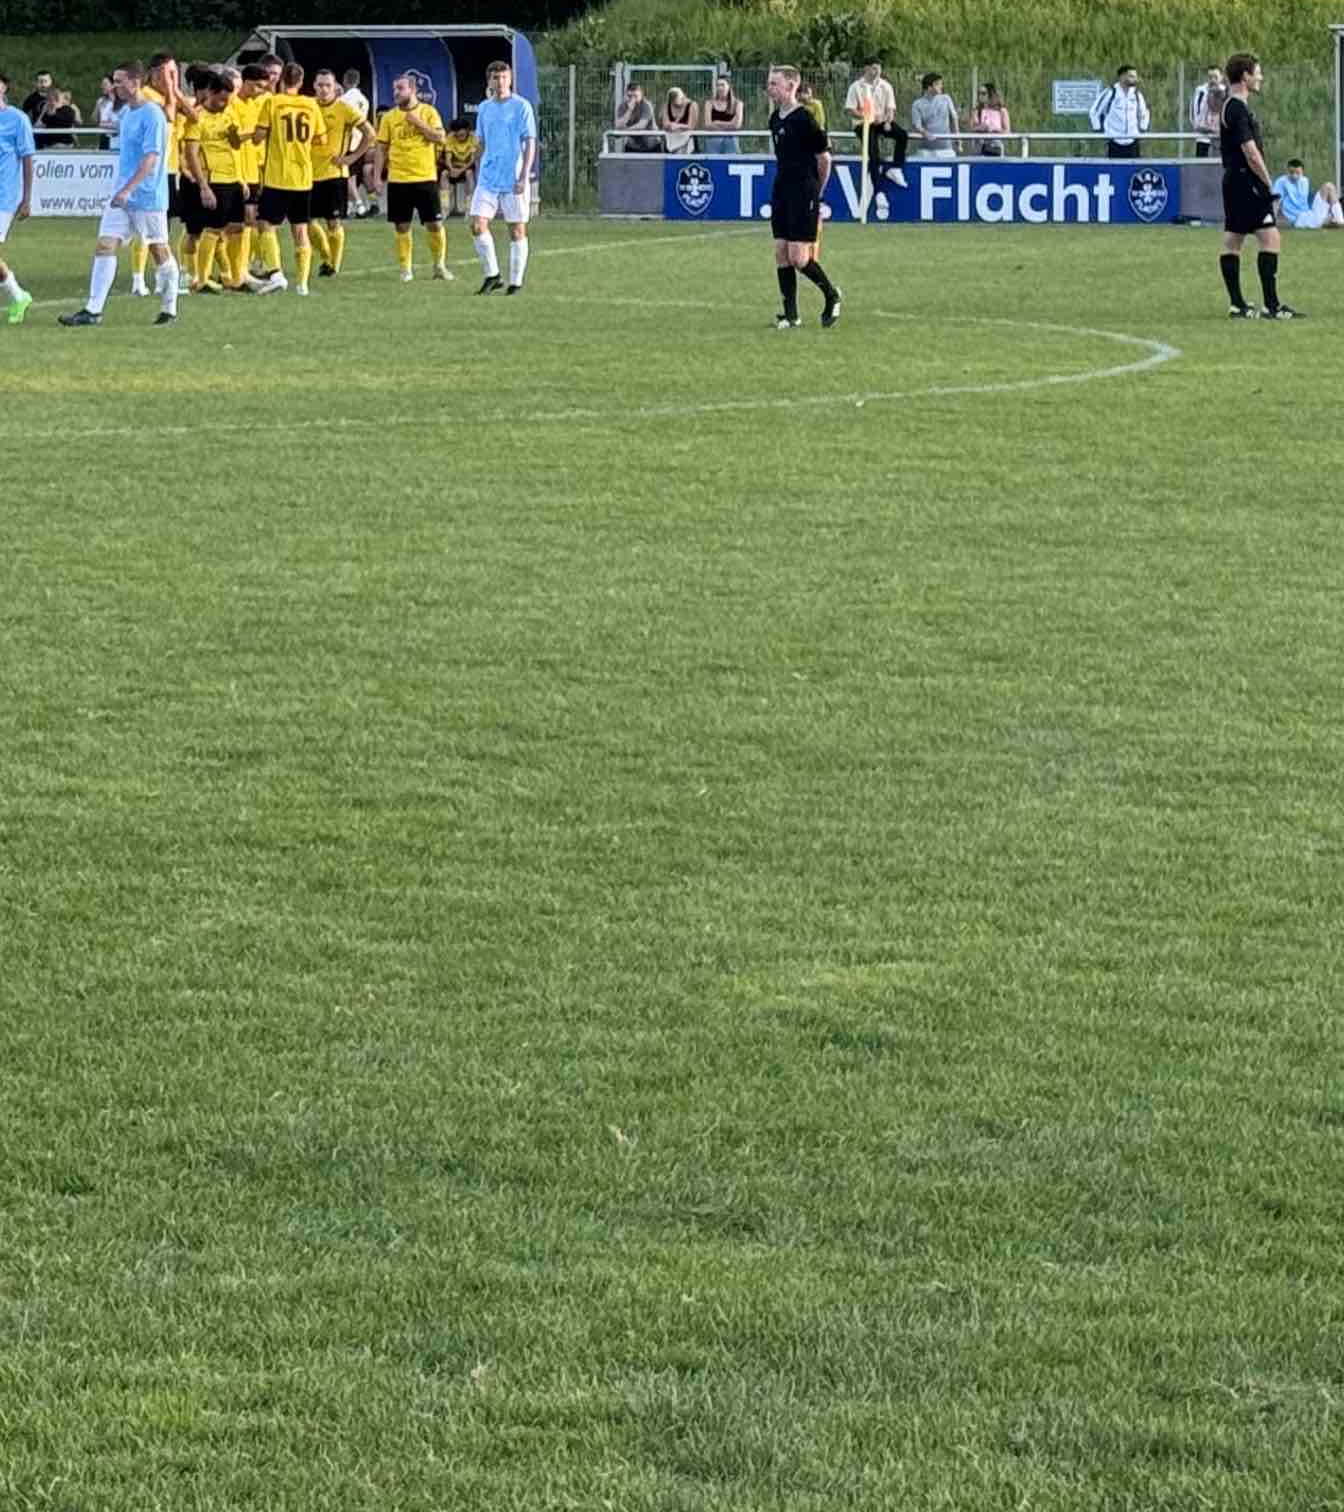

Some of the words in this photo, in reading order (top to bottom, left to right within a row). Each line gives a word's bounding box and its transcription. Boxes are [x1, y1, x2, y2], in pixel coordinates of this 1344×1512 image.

[280, 111, 311, 143] 16
[80, 163, 114, 179] vom
[920, 164, 1115, 223] Flacht
